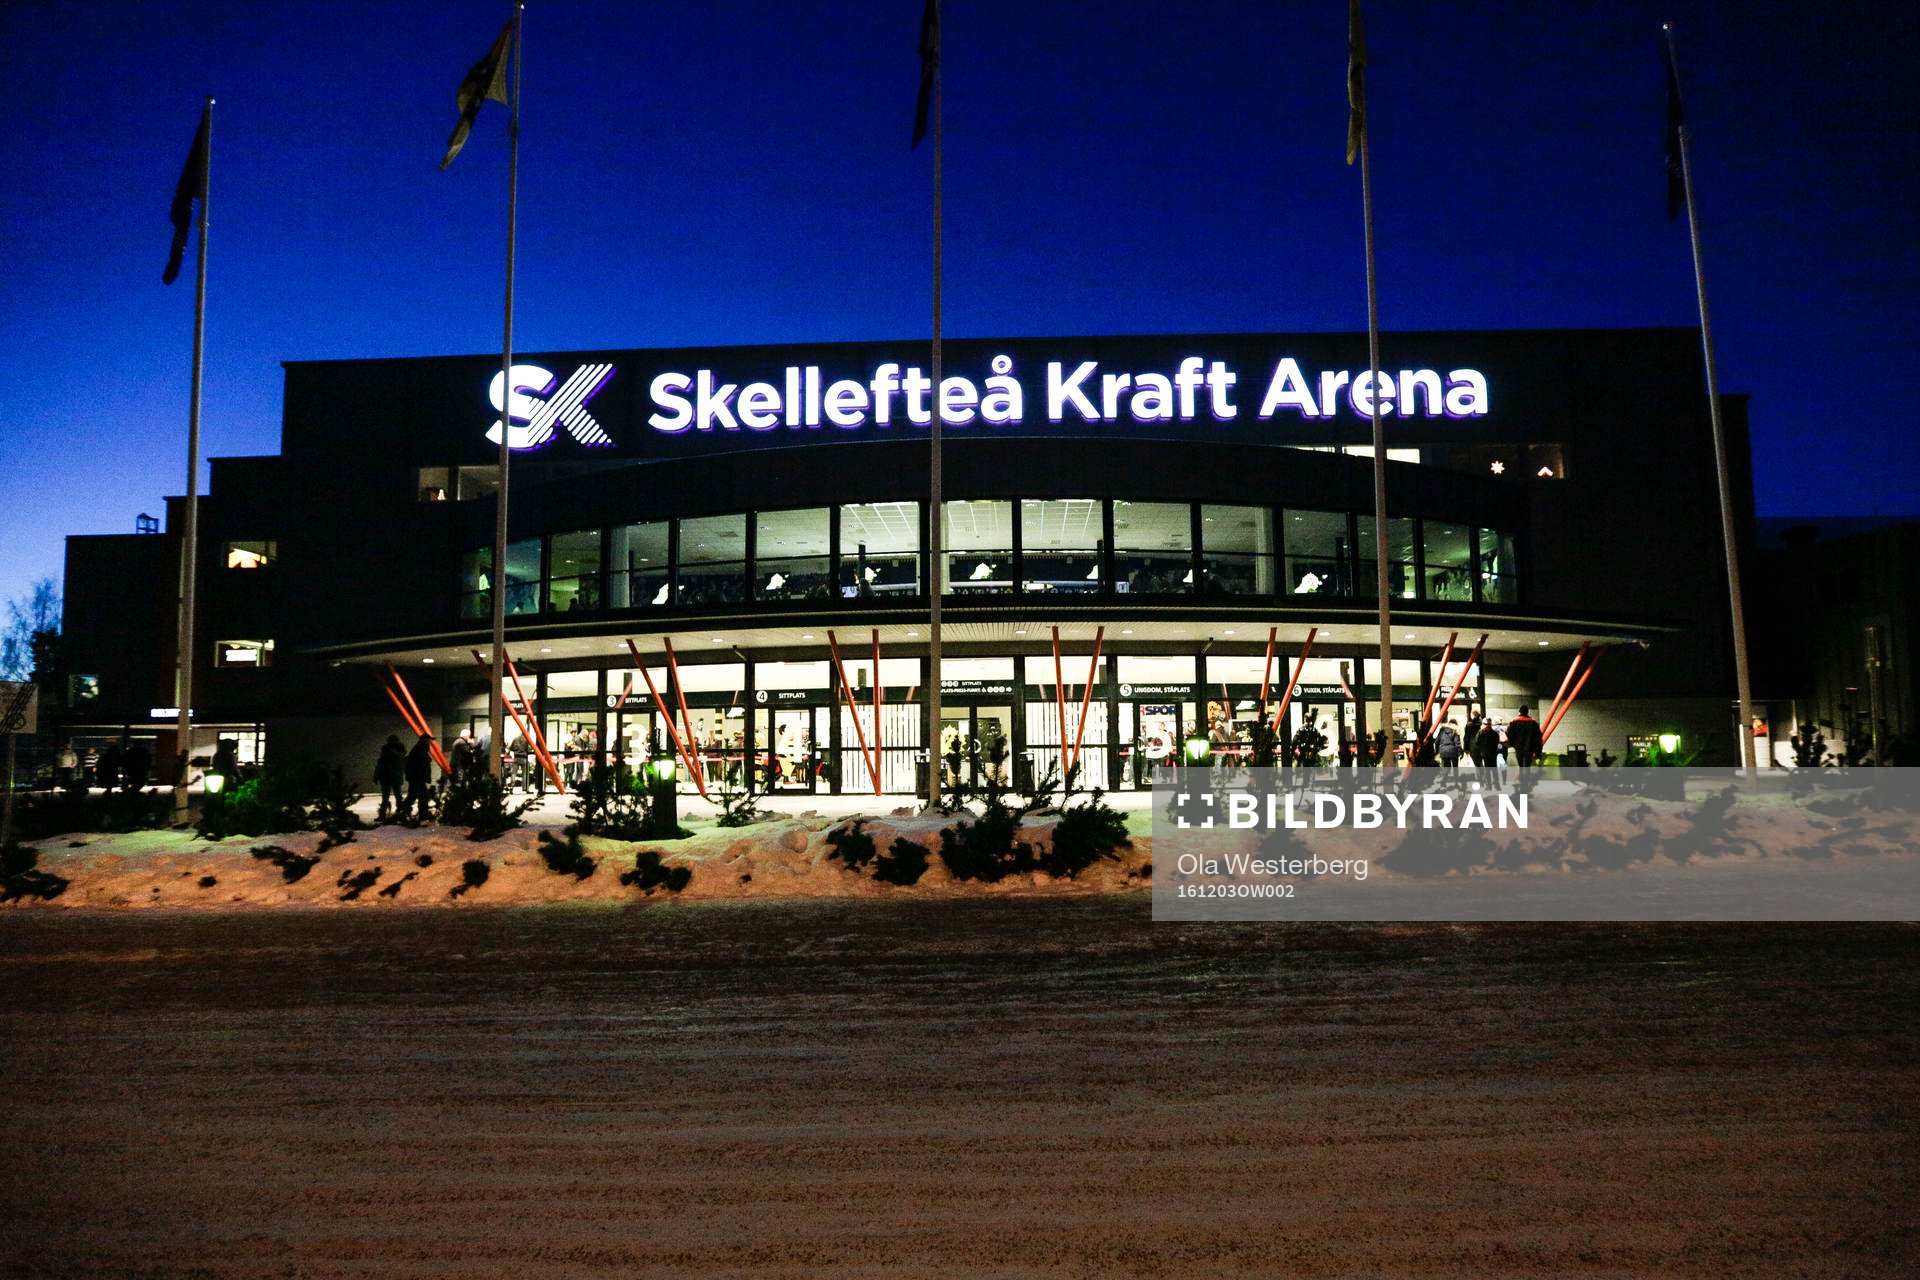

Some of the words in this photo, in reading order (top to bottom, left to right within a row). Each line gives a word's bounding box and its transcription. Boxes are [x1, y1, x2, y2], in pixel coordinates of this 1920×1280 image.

[648, 355, 1022, 431] Skellefteå
[1048, 357, 1237, 420] Kraft
[1260, 357, 1488, 417] Arena
[625, 696, 647, 704] SITTPLATS
[1134, 686, 1163, 694] UNGDOM,
[1164, 685, 1191, 693] STÅPLATS
[624, 724, 647, 766] 3
